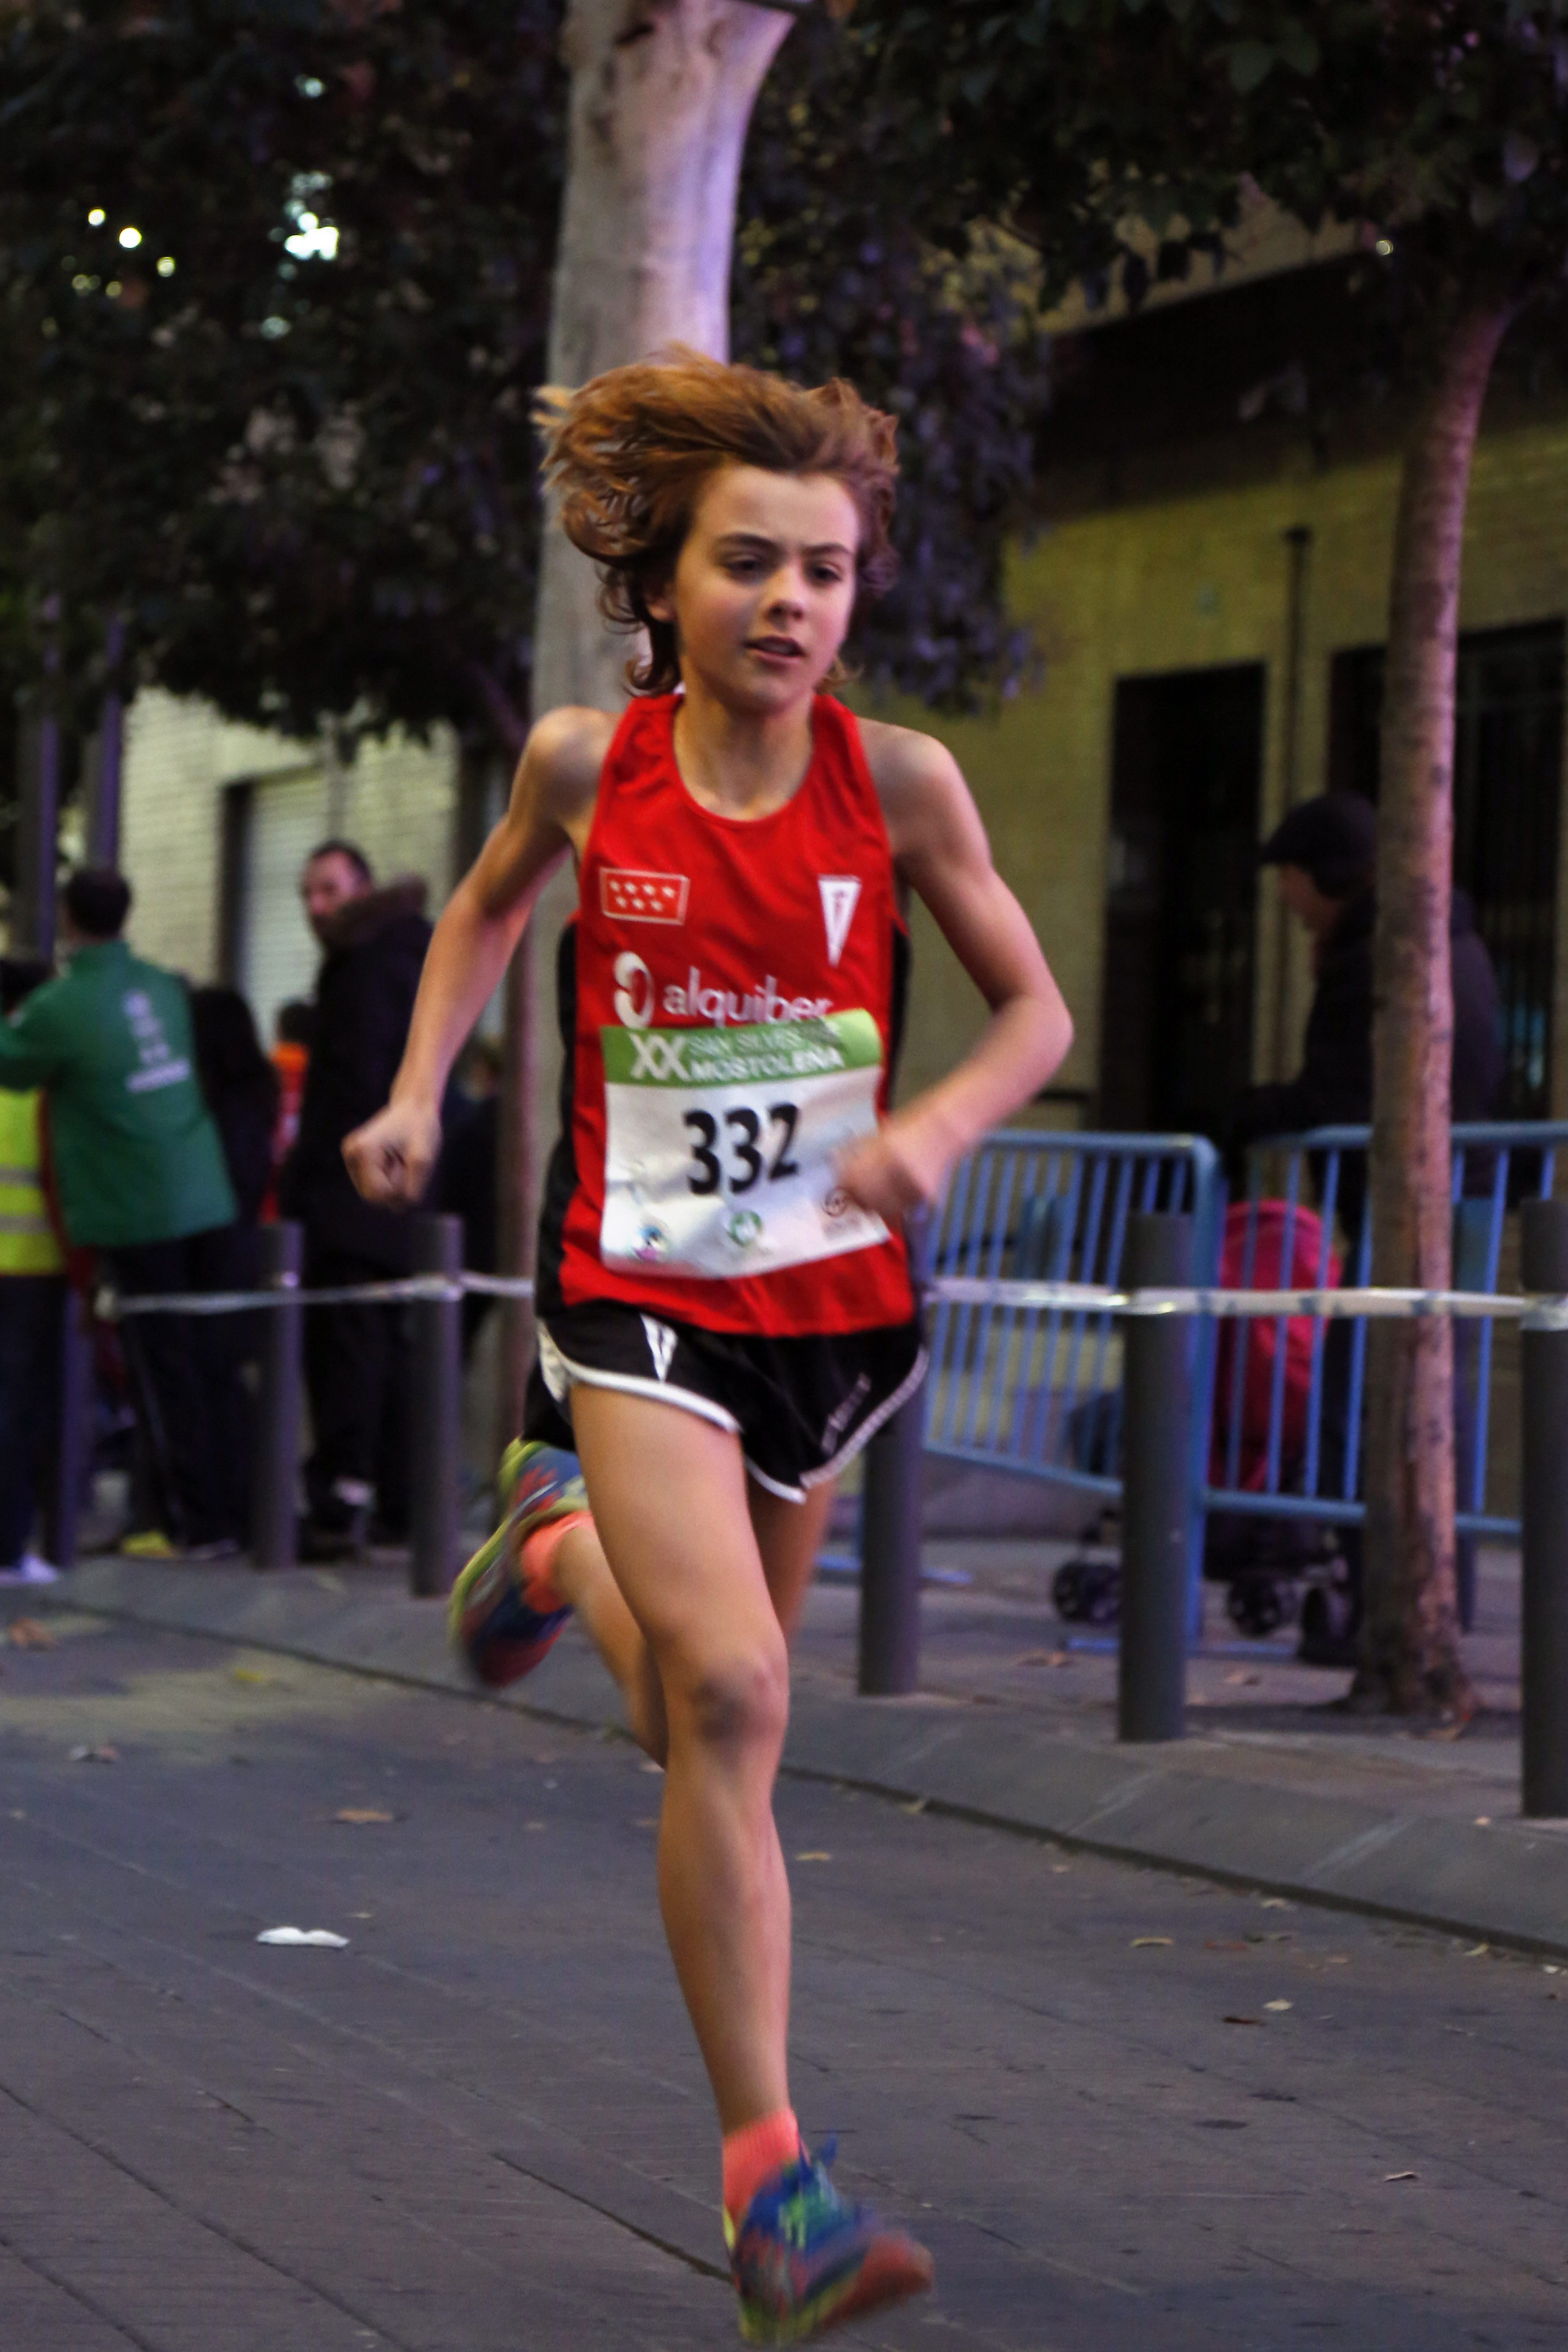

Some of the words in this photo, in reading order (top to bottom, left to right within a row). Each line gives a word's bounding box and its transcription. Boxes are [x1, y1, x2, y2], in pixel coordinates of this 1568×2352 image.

[663, 965, 834, 1028] alquiber
[627, 1032, 693, 1082] XX
[682, 1101, 800, 1196] 332
